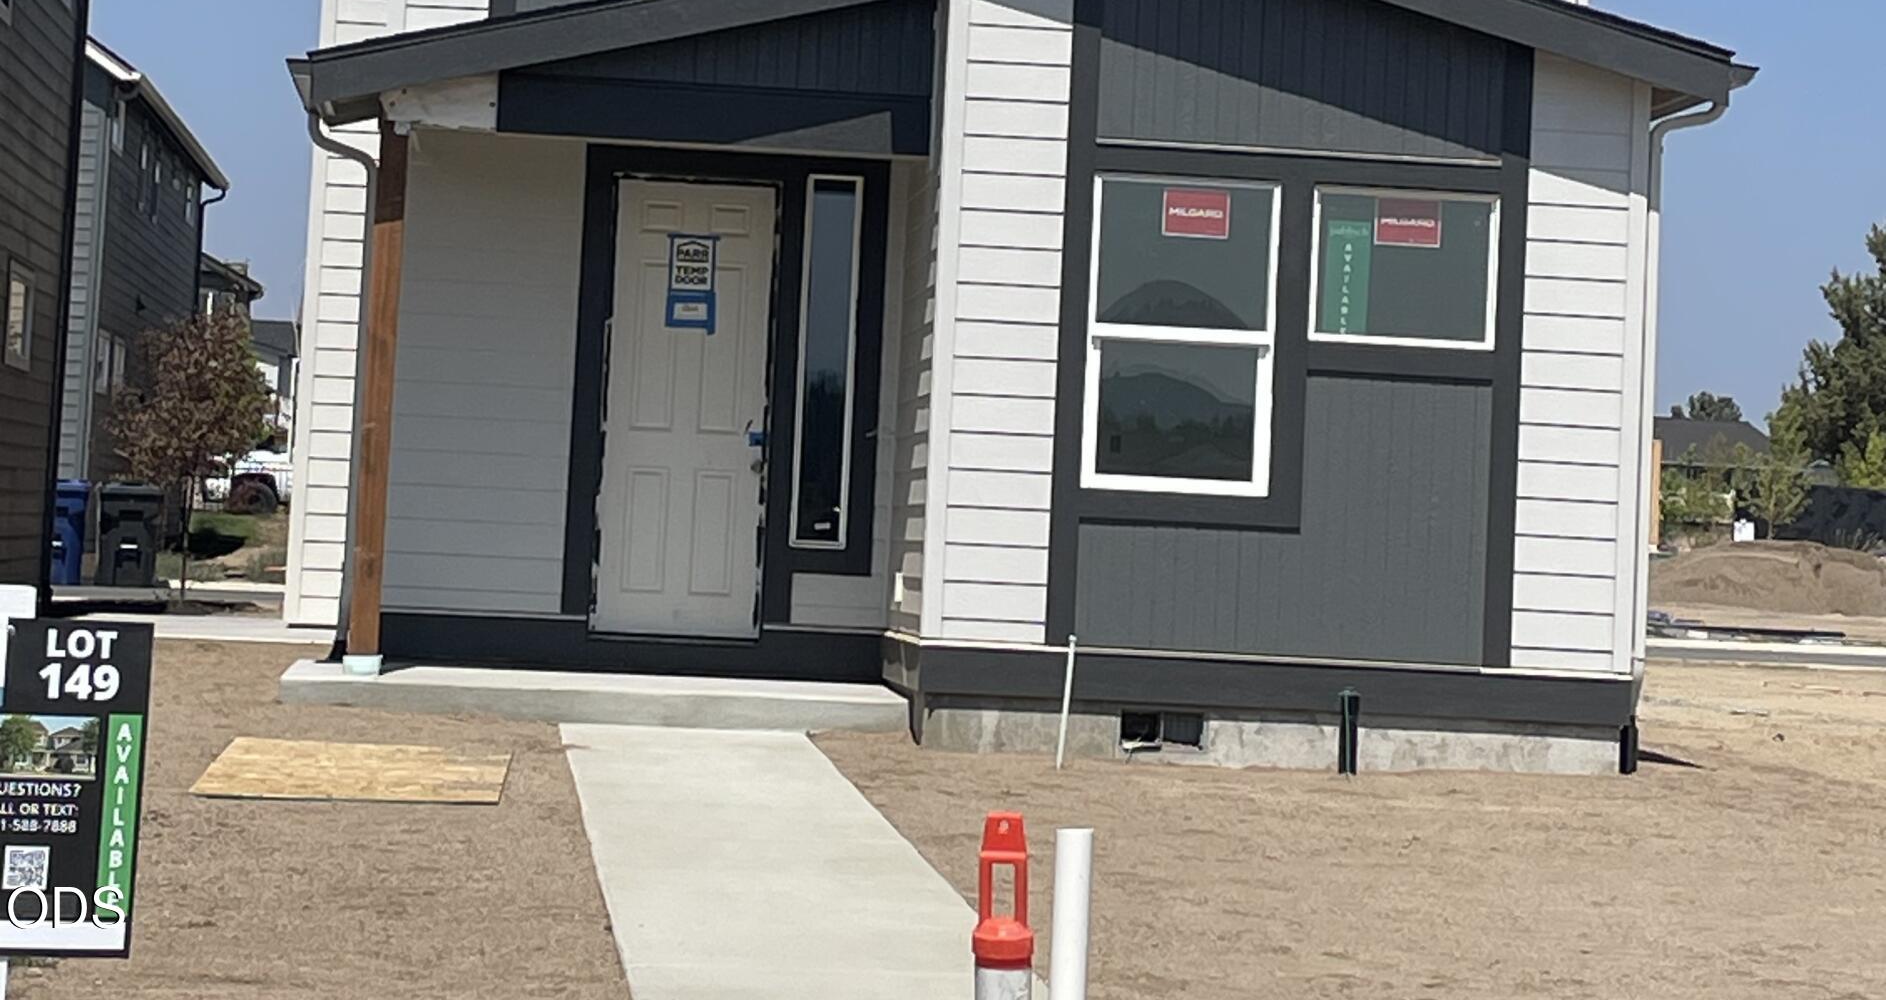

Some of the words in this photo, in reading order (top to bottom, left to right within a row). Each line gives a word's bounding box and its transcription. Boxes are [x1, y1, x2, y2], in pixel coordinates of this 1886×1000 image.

[1168, 207, 1224, 218] MILGARD
[677, 248, 709, 258] PARR
[676, 265, 709, 275] TEMP
[674, 275, 707, 285] DOOR
[46, 628, 118, 659] LOT
[39, 662, 120, 701] 149
[0, 802, 16, 815] LL
[20, 802, 39, 815] OR
